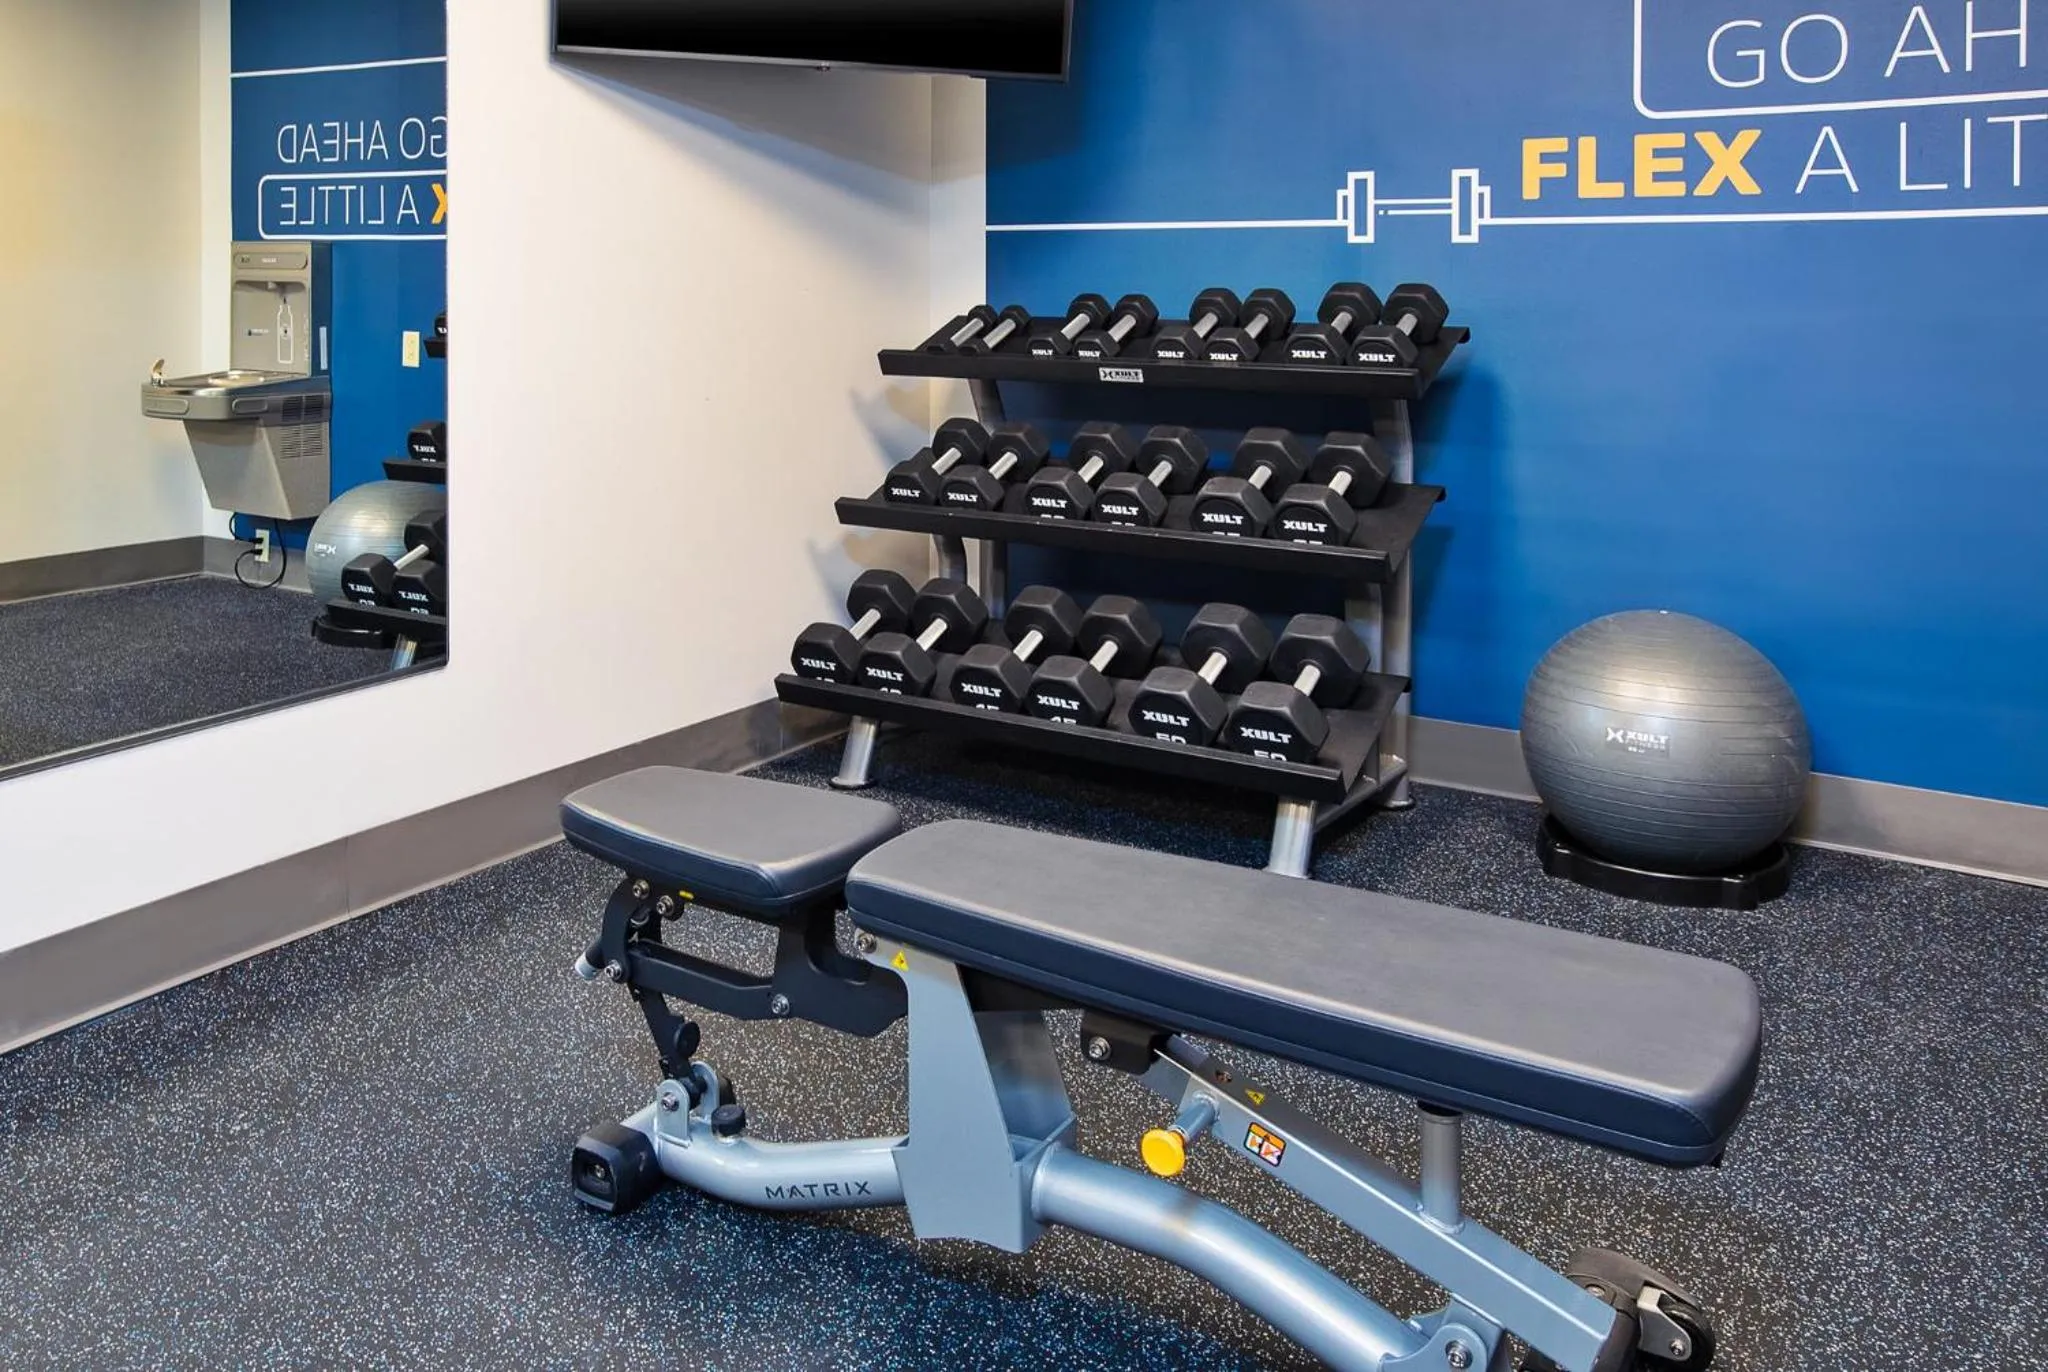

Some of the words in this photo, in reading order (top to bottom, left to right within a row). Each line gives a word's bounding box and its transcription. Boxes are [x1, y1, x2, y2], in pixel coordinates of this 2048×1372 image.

[1707, 13, 1849, 88] GO
[1884, 0, 2029, 77] AH
[1522, 129, 1762, 200] FLEX
[1795, 125, 1859, 194] A
[1900, 113, 2048, 191] LIT
[1157, 350, 1185, 358] XULT
[1209, 352, 1239, 361] XULT
[1291, 350, 1328, 359] XULT
[1358, 352, 1396, 363] XULT
[891, 487, 921, 498] XULT
[947, 492, 979, 503] XULT
[1032, 496, 1068, 509] XULT
[1101, 503, 1139, 516] XULT
[1202, 512, 1244, 525] XULT
[1283, 519, 1328, 533] XULT
[801, 657, 837, 671] XULT
[865, 666, 904, 682] XULT
[961, 682, 1002, 698] XULT
[1037, 694, 1080, 711] XULT
[1142, 709, 1190, 727] XULT
[1240, 727, 1292, 744] XULT
[765, 1180, 871, 1199] MATRIX
